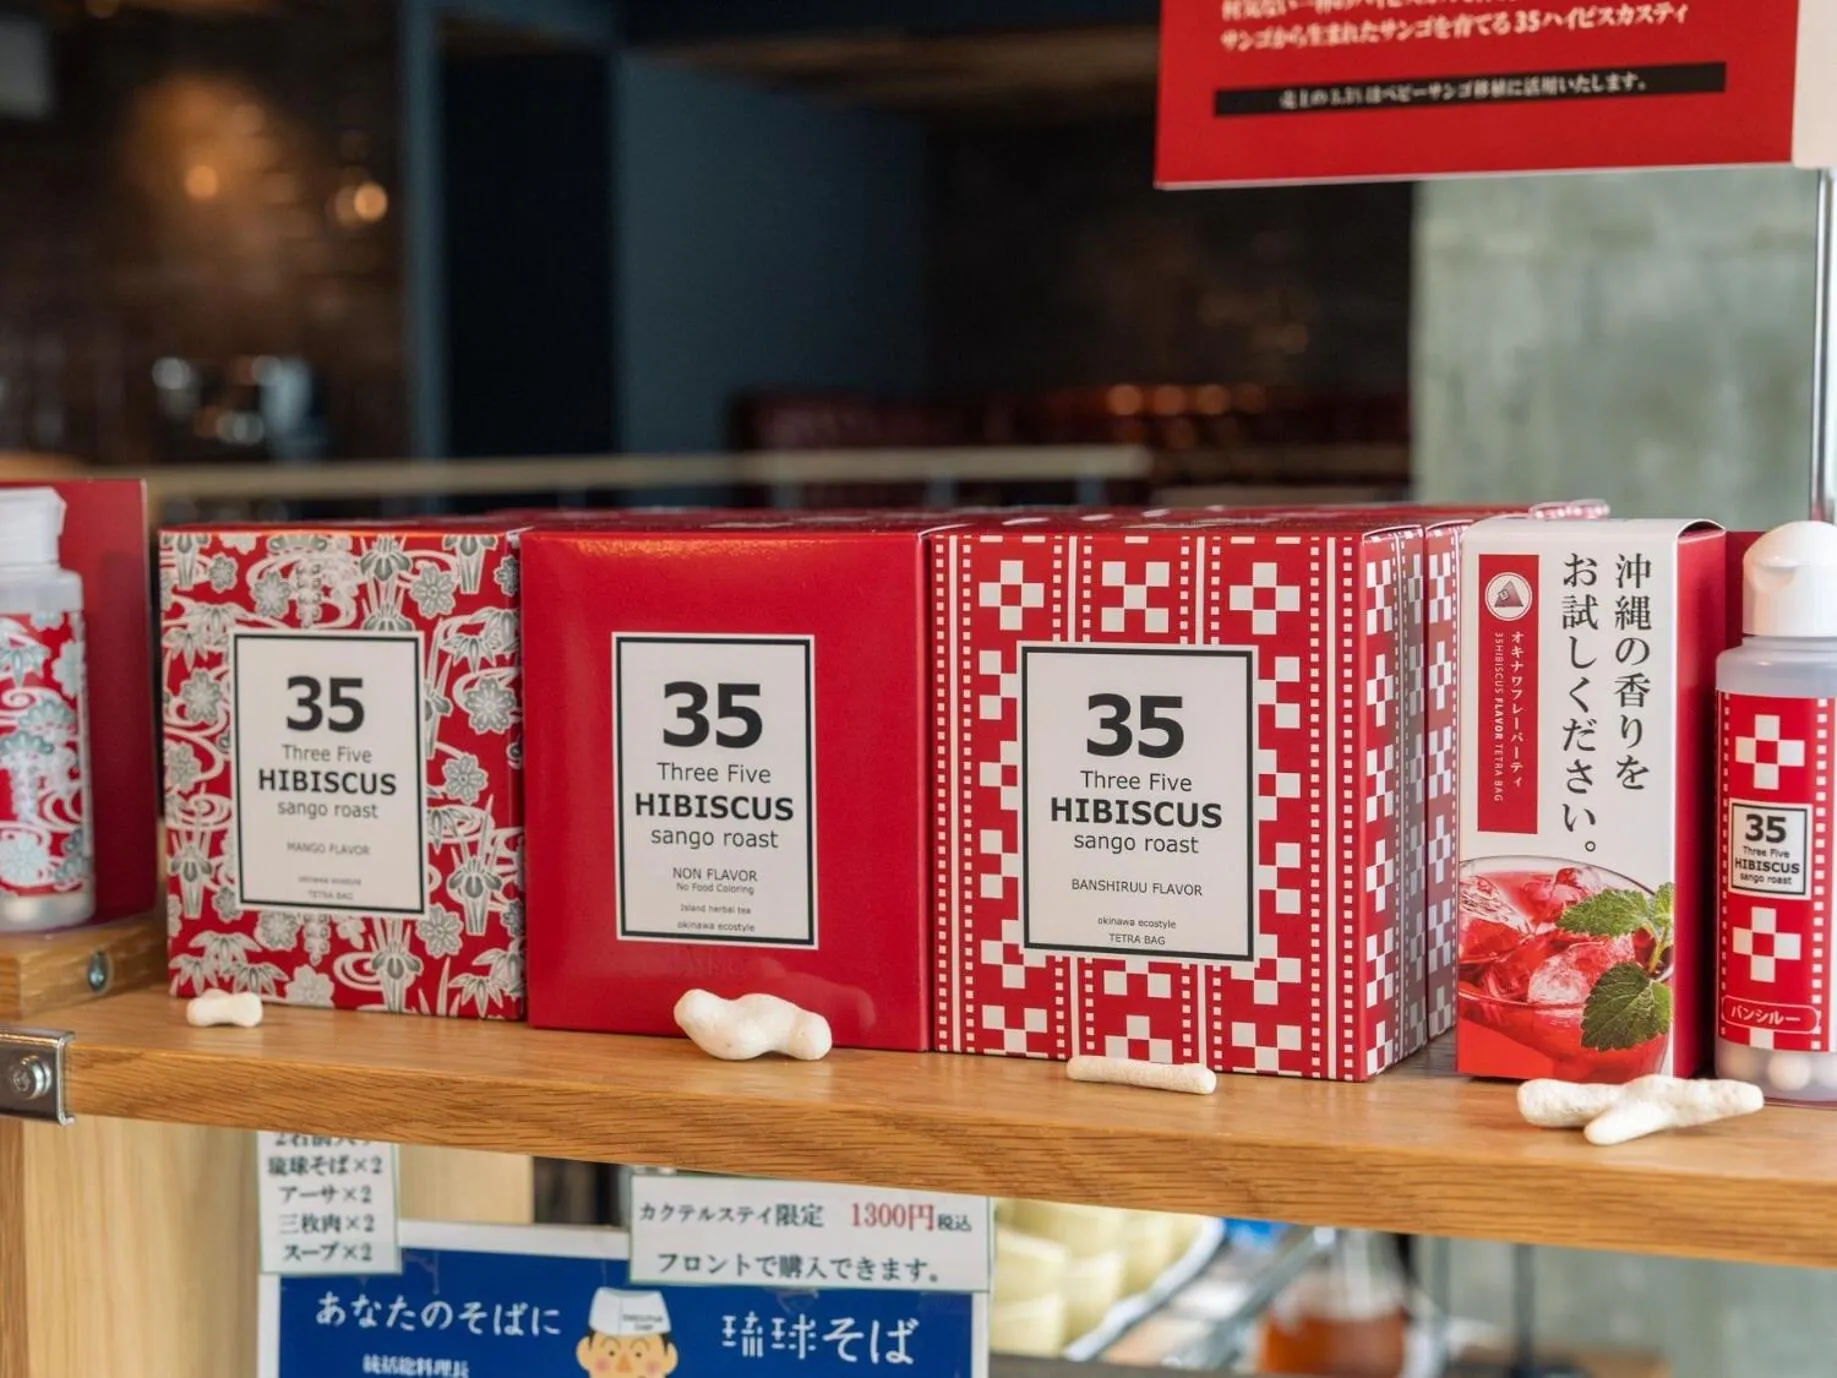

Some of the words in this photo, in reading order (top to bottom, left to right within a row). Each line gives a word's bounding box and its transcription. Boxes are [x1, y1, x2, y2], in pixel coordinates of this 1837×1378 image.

[1615, 553, 1652, 790] 沖縄の香りを
[286, 675, 365, 733] 35
[1511, 631, 1524, 787] オキナワフレーバーティ
[1562, 553, 1598, 853] お試しください。
[663, 681, 763, 748] 35
[1494, 697, 1504, 740] FLAVOR
[1086, 693, 1184, 758] 35
[281, 744, 331, 762] Three
[337, 746, 373, 763] Five
[259, 769, 396, 795] HIBISCUS
[657, 762, 718, 782] Three
[728, 764, 771, 783] Five
[1081, 771, 1141, 790] Three
[1150, 773, 1192, 791] Five
[277, 801, 328, 819] sango
[334, 802, 378, 818] roast
[635, 793, 793, 821] HIBISCUS
[1051, 797, 1222, 828] HIBISCUS
[1745, 814, 1786, 843] 35
[287, 842, 326, 854] MANGO
[329, 843, 370, 855] FLAVOR
[651, 829, 714, 849] sango
[724, 830, 778, 848] roast
[1074, 834, 1136, 854] sango
[1145, 836, 1199, 853] roast
[1743, 845, 1766, 857] Three
[672, 868, 702, 880] NON
[707, 868, 758, 882] FLAVOR
[1735, 858, 1800, 874] HIBISCUS
[1071, 879, 1148, 893] BANSHIRUU
[1152, 883, 1202, 896] FLAVOR
[1740, 873, 1765, 884] sango
[692, 883, 713, 892] Food
[716, 883, 754, 896] Coloring
[717, 923, 755, 932] ecostyle
[1098, 916, 1135, 927] okinawa
[1138, 918, 1177, 929] ecostyle
[1109, 934, 1141, 944] TETRA
[1144, 935, 1166, 945] BAG
[1731, 1006, 1801, 1025] バンシルー
[657, 1252, 939, 1283] フロントで購入できます。
[315, 1290, 562, 1336] あなたのそばに
[722, 1311, 920, 1365] 琉球そば
